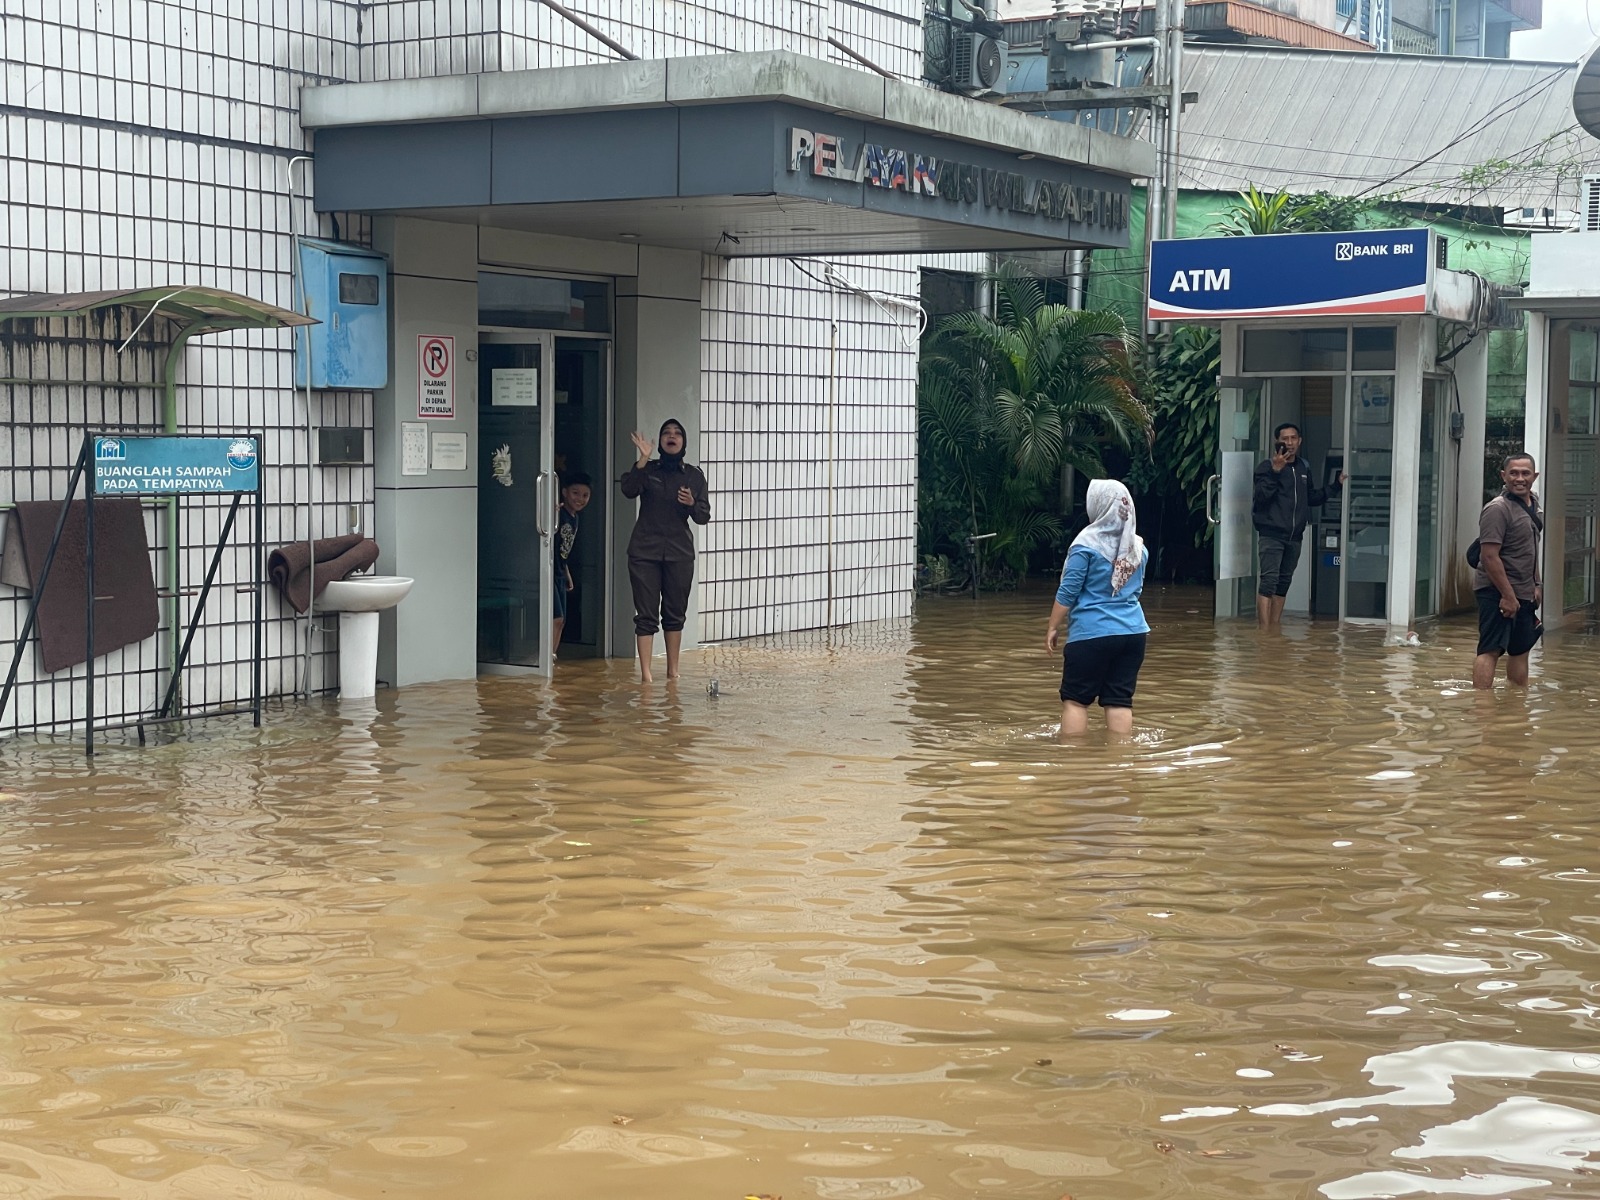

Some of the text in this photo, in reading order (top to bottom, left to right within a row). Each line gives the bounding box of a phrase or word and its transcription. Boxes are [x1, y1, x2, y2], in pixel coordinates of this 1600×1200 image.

[787, 126, 979, 203] PELAYANAN
[1353, 243, 1414, 256] BANK BRI
[1168, 268, 1231, 293] ATM
[97, 466, 231, 477] BUANGLAH SAMPAH
[103, 478, 224, 489] PADA TEMPATNYA
